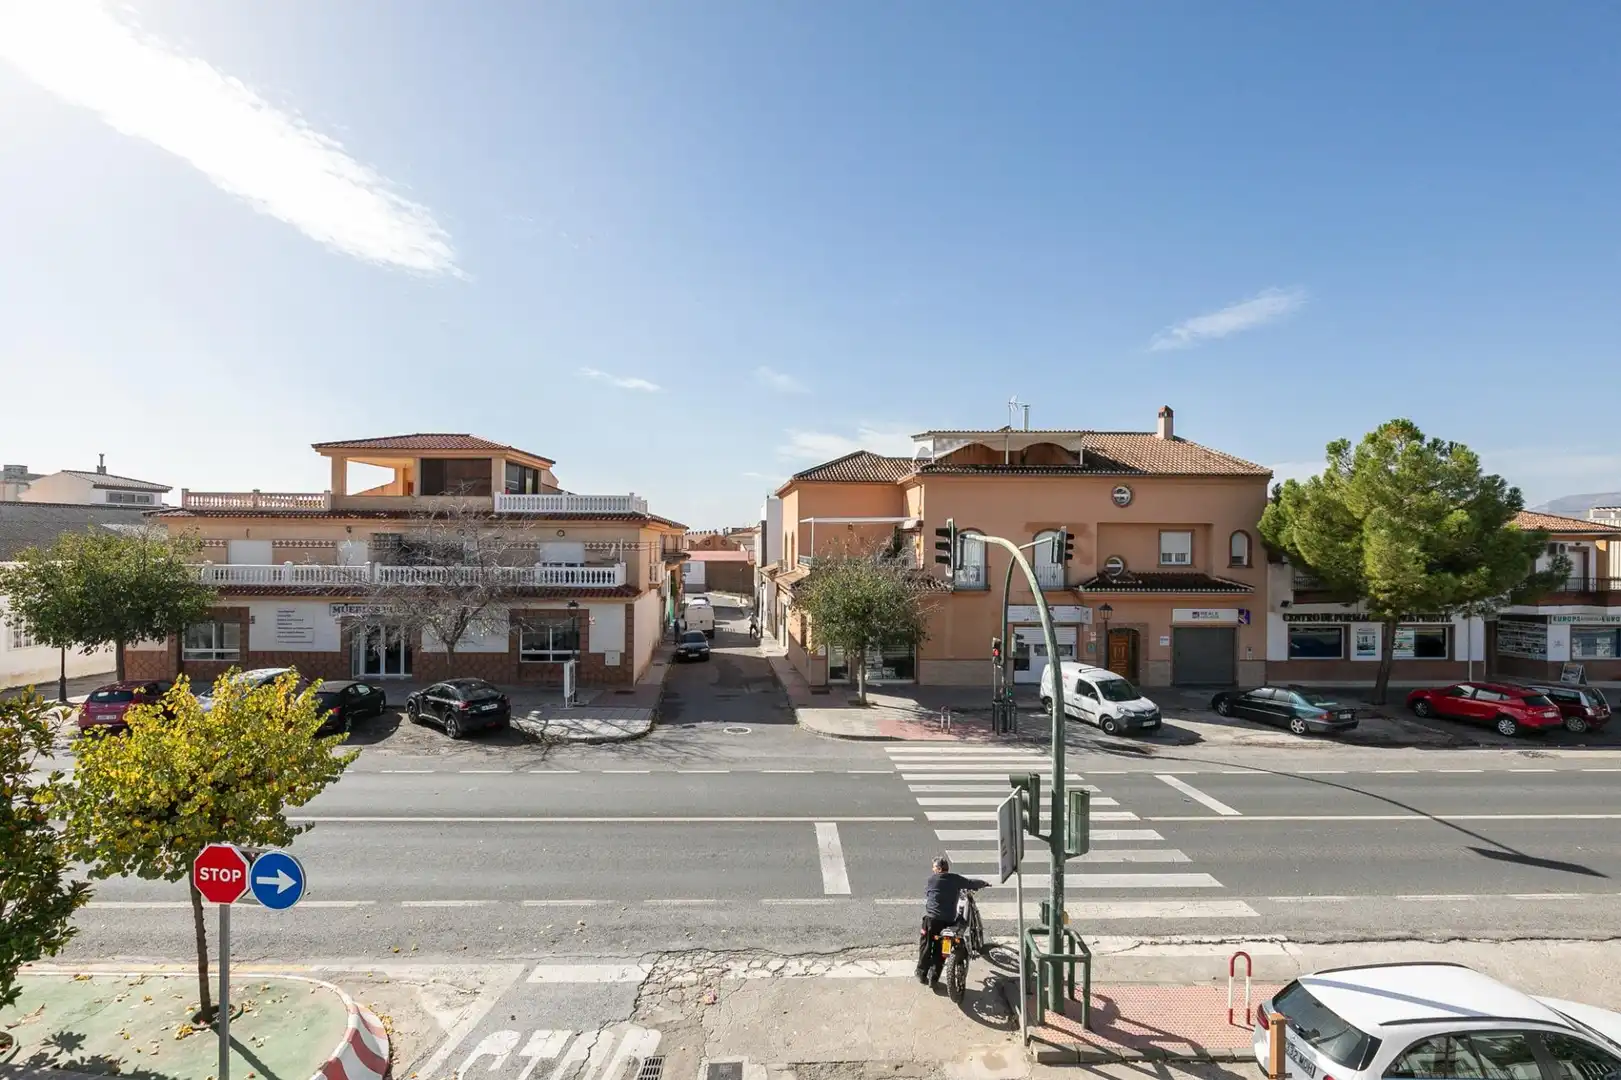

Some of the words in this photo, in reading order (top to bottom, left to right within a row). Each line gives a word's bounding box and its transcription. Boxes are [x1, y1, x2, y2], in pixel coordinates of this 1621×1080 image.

[1283, 613, 1320, 622] CENTRO
[1321, 613, 1334, 622] DE
[200, 867, 241, 882] STOP
